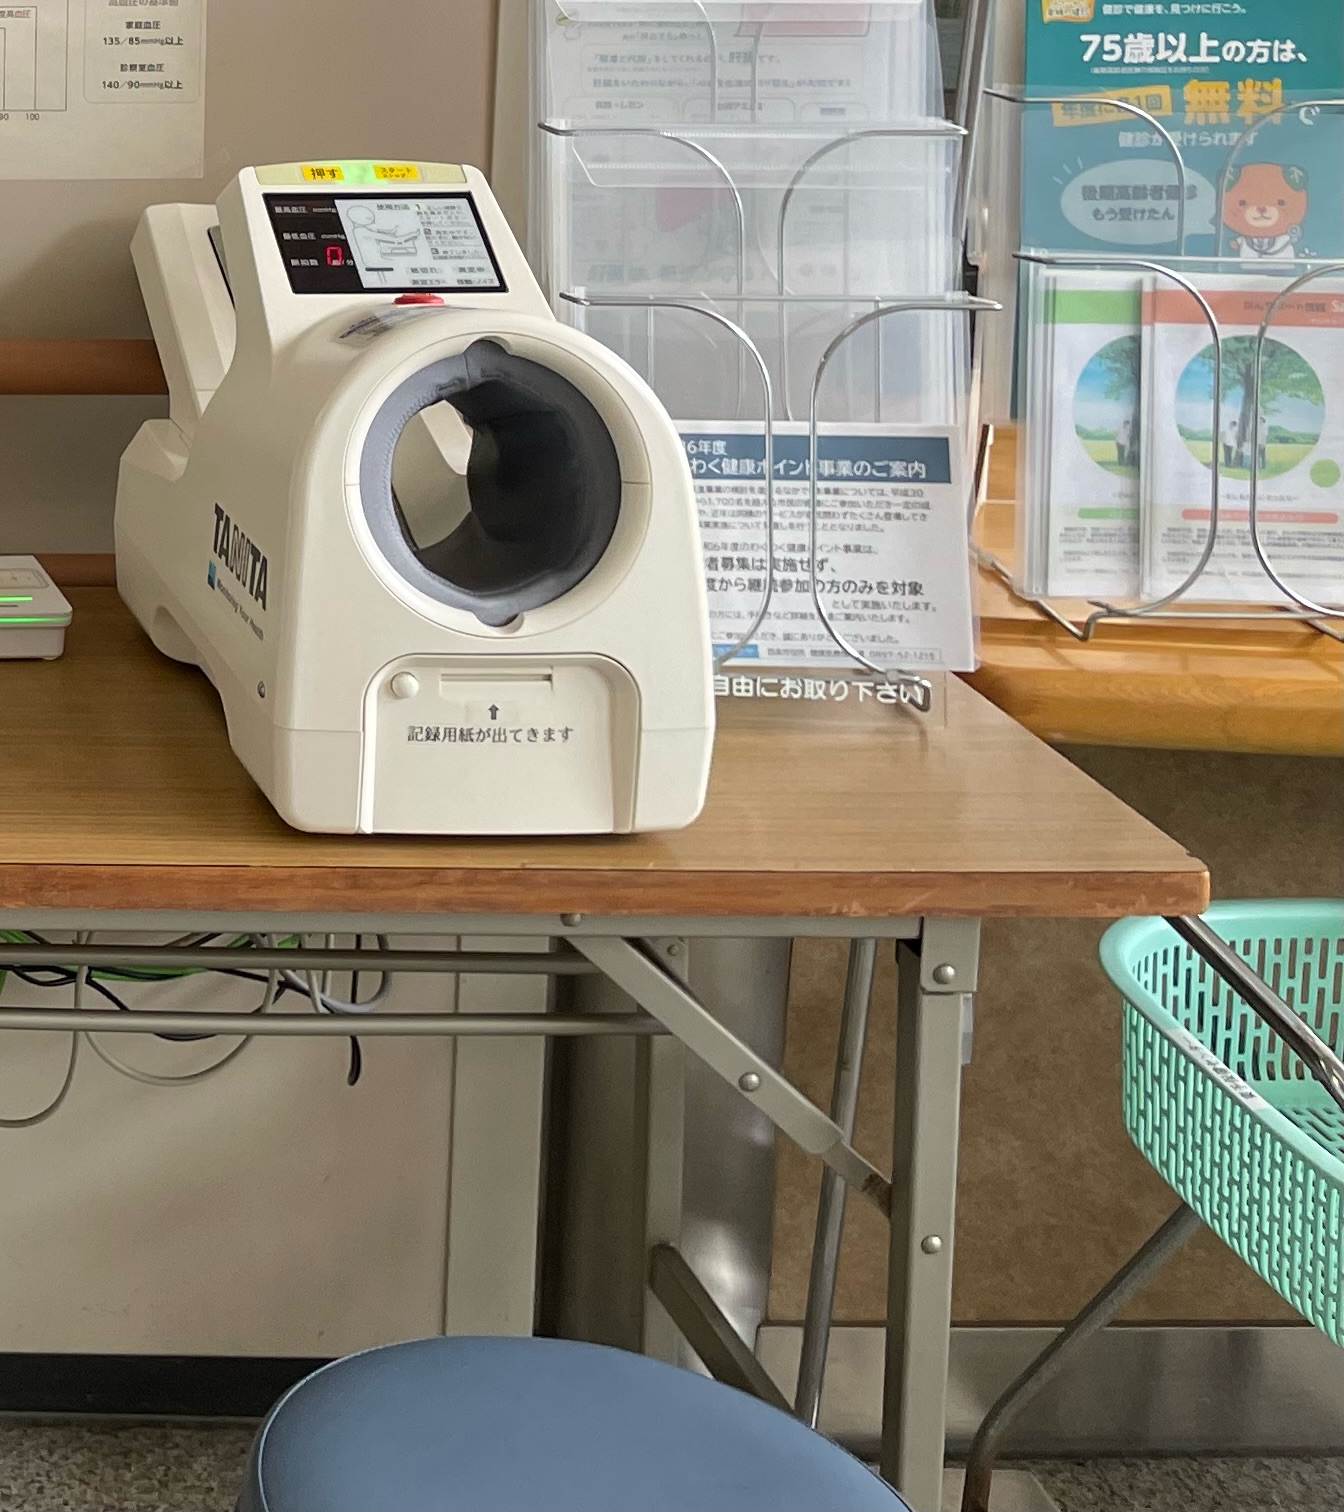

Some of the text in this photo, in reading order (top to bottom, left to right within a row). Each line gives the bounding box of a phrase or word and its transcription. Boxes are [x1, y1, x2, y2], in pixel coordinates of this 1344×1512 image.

[1080, 32, 1308, 64] 75歳以上の方は、
[1182, 77, 1285, 126] 無料
[0, 113, 9, 121] 90
[25, 113, 40, 121] 100
[311, 168, 338, 179] 押す
[214, 502, 267, 612] TANITA
[407, 726, 574, 744] 記録用紙が出てきます
